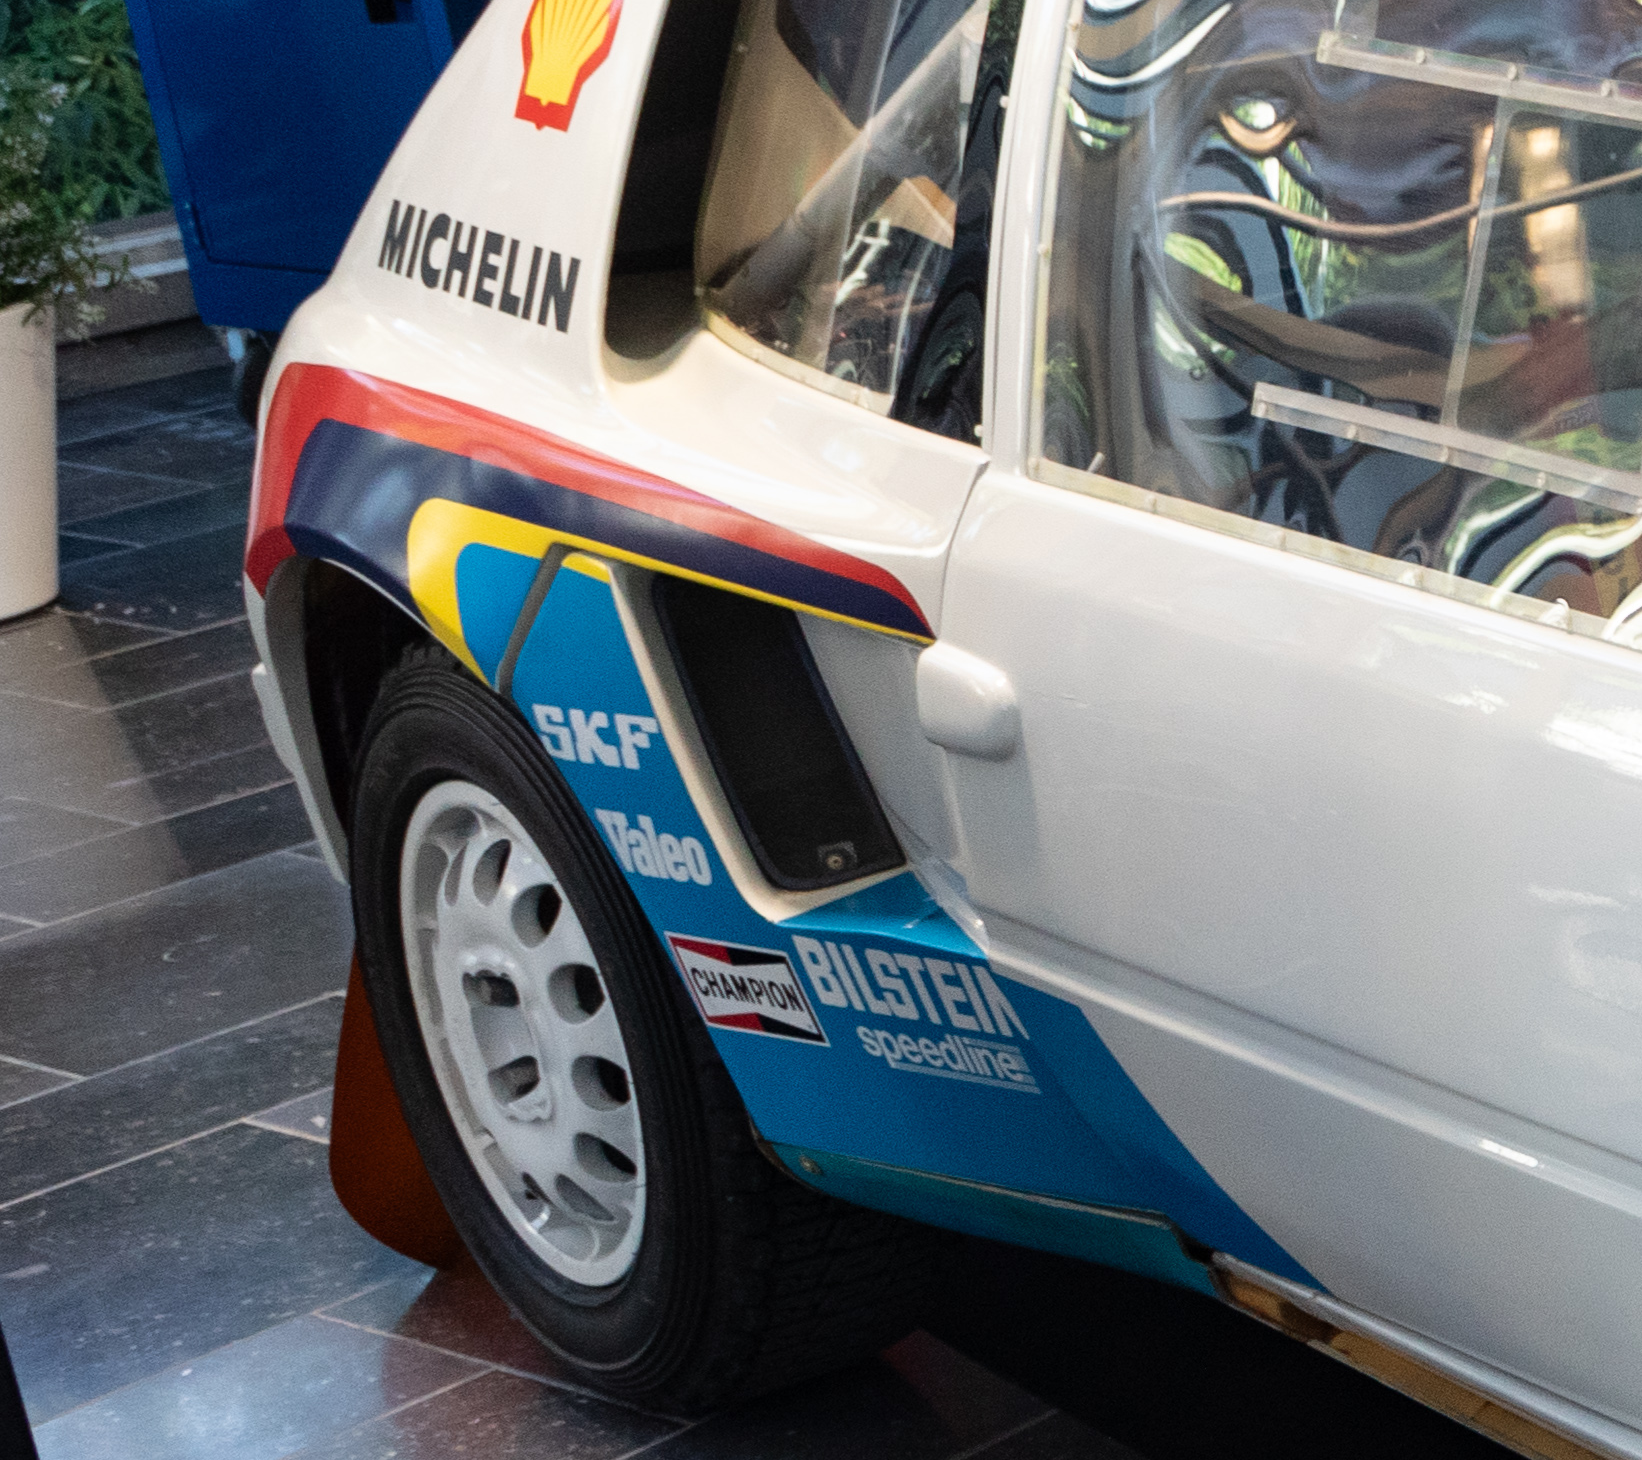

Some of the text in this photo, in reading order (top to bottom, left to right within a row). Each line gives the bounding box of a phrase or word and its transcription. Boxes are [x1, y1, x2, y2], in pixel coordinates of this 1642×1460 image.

[376, 199, 581, 335] MICHELIN
[531, 703, 661, 771] SKF
[595, 809, 712, 887] Valeo
[689, 966, 805, 1013] CHAMPION
[791, 934, 1031, 1041] BILSTEIN
[856, 1025, 1026, 1084] speedline
